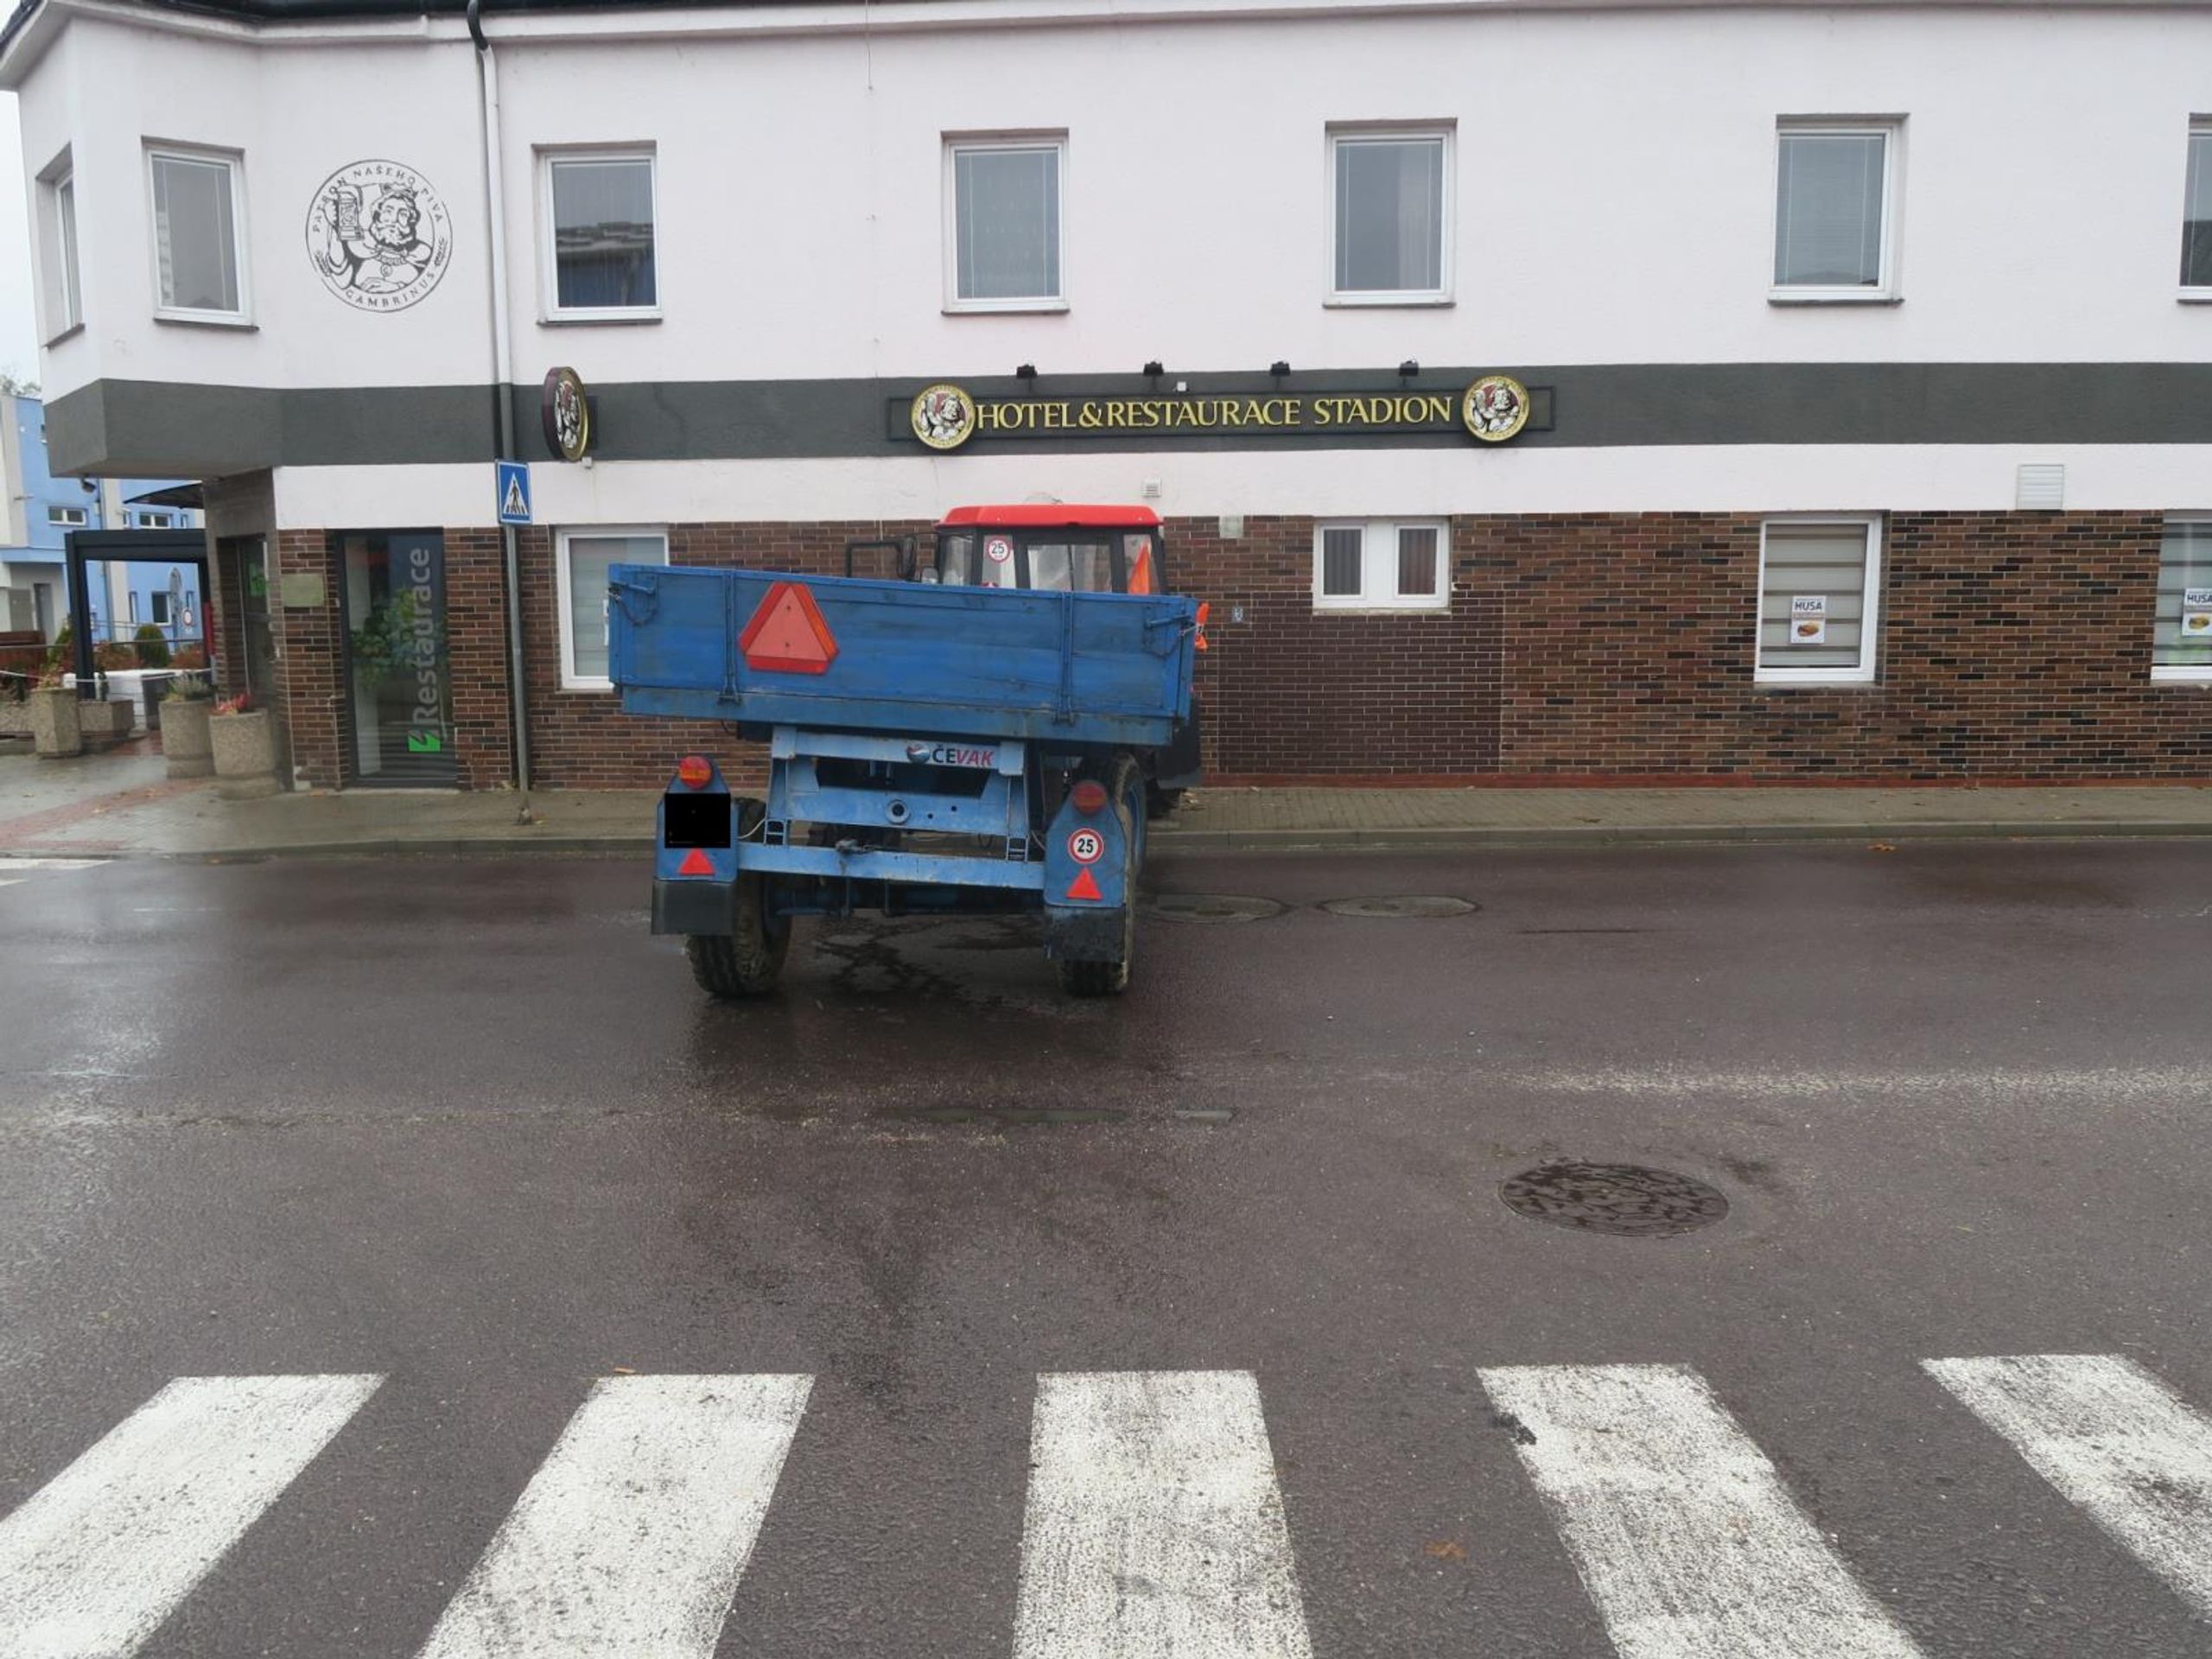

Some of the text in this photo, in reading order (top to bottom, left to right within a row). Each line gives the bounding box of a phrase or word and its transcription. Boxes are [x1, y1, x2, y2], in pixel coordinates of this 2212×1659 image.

[346, 272, 435, 307] GAMBRINUS
[1314, 396, 1453, 424] STADION
[991, 542, 1005, 554] 25
[1795, 601, 1822, 611] HUSA
[410, 548, 439, 734] Restaurace
[932, 744, 994, 766] ČEVAK
[1077, 838, 1094, 853] 25
